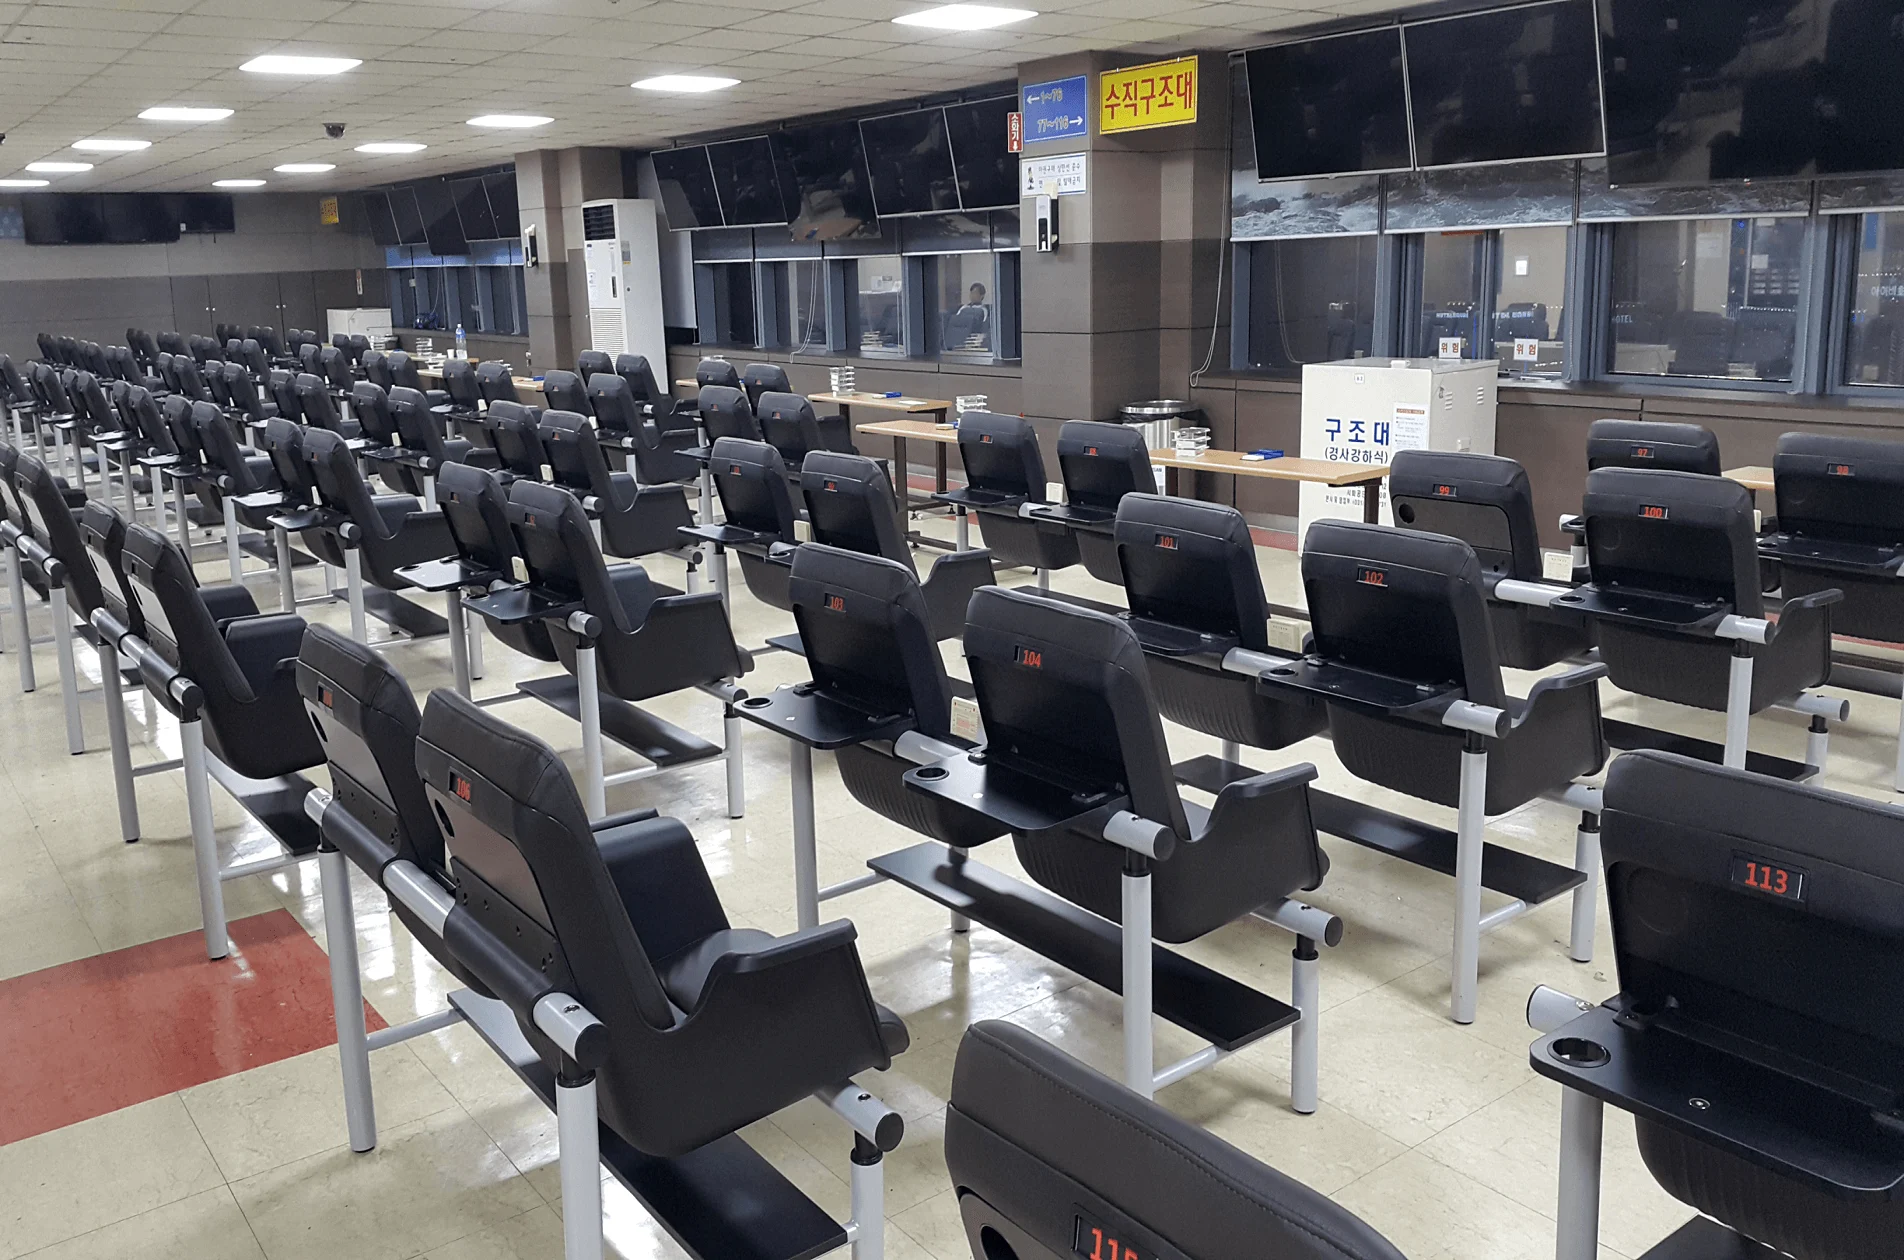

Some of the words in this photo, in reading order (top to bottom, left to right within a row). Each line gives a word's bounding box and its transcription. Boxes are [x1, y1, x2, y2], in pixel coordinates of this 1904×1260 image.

[1104, 71, 1193, 120] 수직구조대
[1011, 113, 1020, 141] 소화기
[1325, 418, 1390, 446] 구조대
[1324, 446, 1389, 464] (경사강하식)
[1637, 448, 1648, 457] 97
[1439, 485, 1450, 496] 99
[1644, 506, 1663, 519] 100
[1160, 535, 1174, 548] 101
[1364, 570, 1384, 585] 102
[830, 596, 844, 611] 103
[1023, 649, 1041, 668] 104
[1744, 862, 1789, 895] 113
